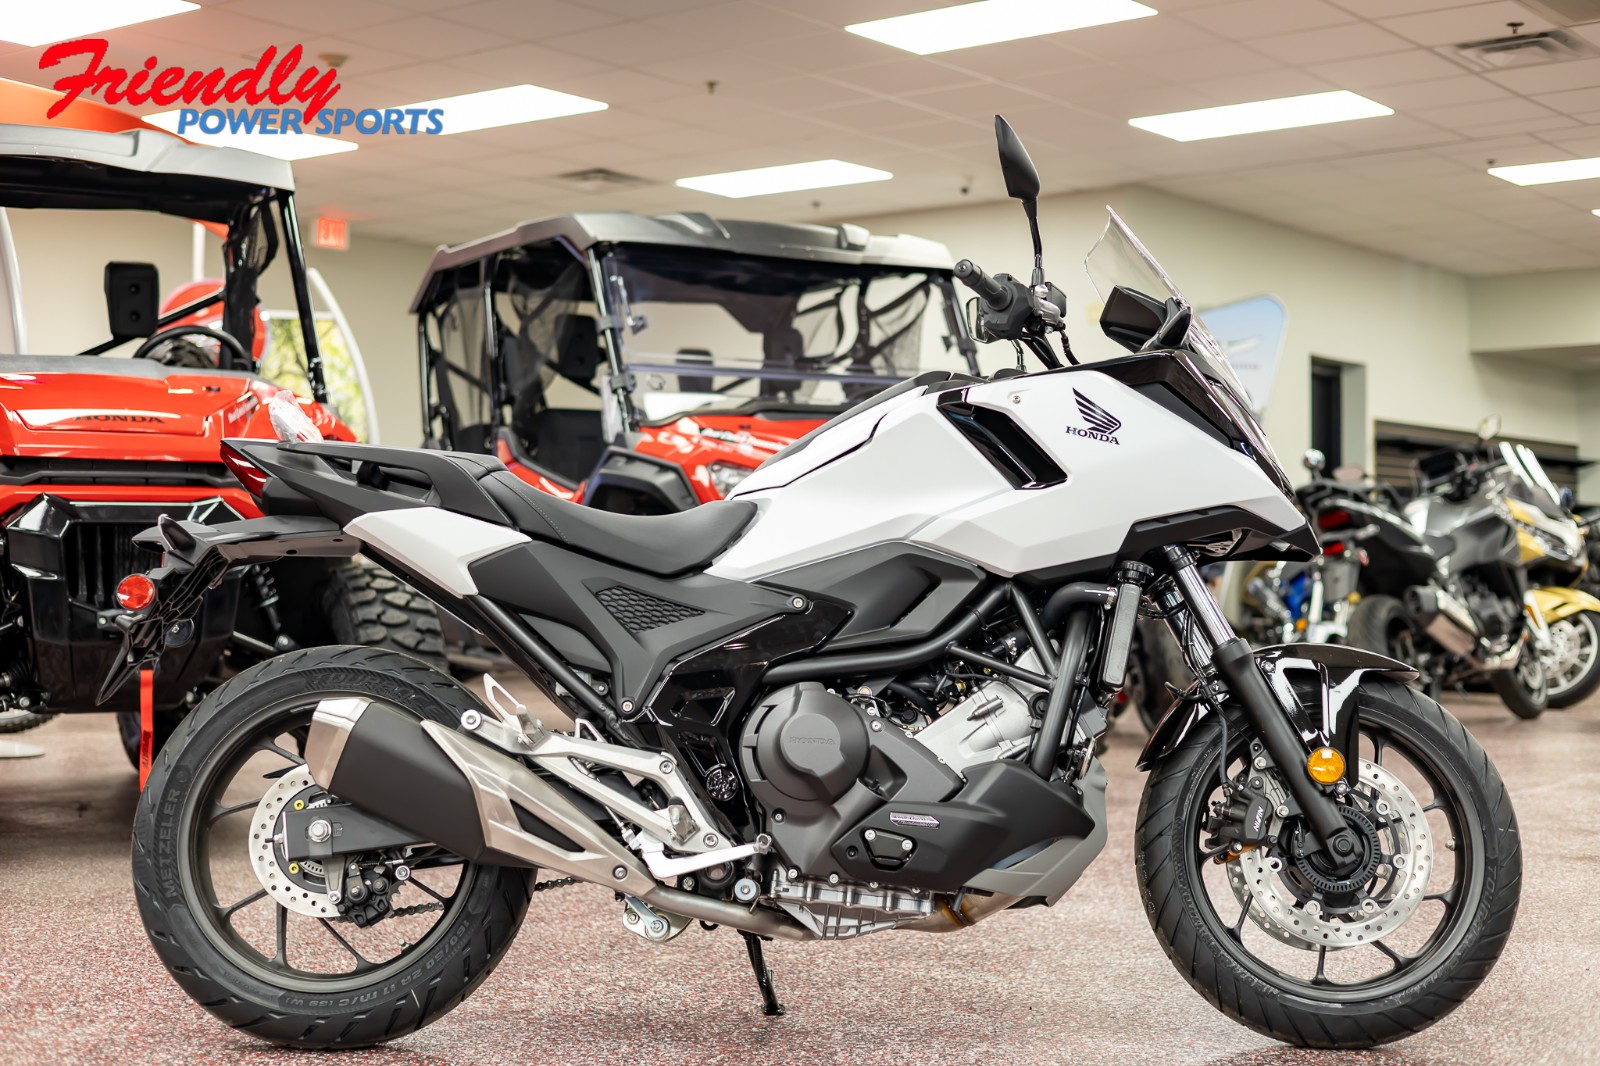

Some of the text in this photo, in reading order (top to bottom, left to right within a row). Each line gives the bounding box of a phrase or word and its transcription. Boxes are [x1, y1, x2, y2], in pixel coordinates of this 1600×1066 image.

[1065, 426, 1120, 446] HONDA
[789, 736, 837, 745] HONDA
[159, 788, 181, 898] METZELER
